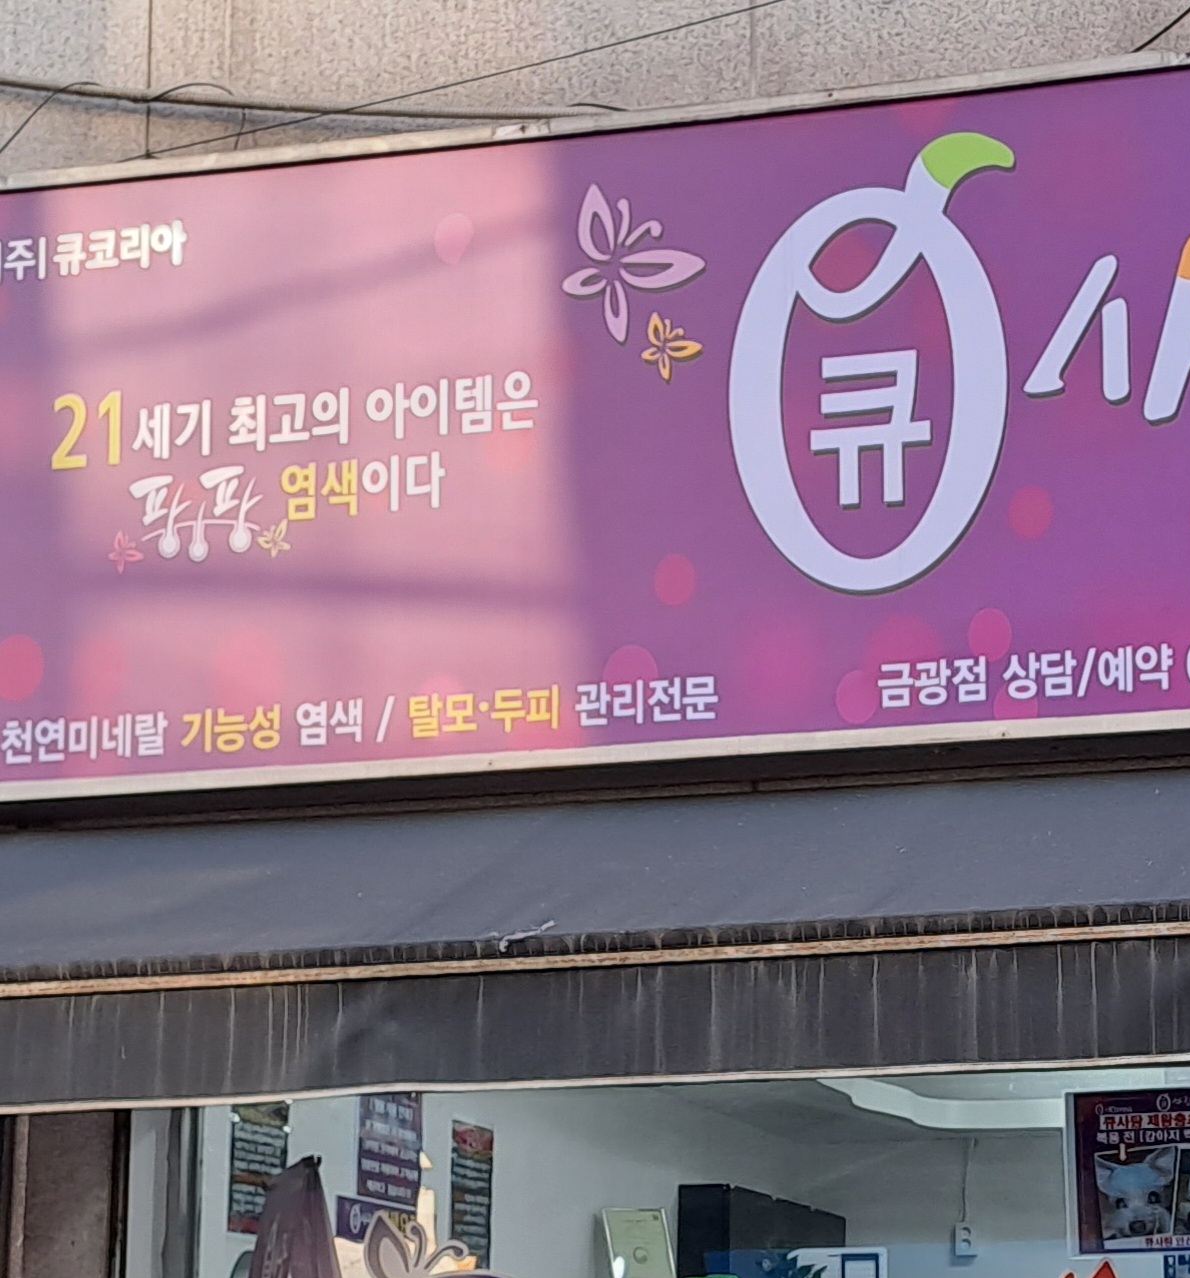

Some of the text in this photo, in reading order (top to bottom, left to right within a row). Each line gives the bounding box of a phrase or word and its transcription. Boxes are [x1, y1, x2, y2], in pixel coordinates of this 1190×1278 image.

[53, 219, 188, 276] 큐코리아
[228, 387, 349, 452] 최고의
[365, 371, 539, 443] 아이템은
[877, 657, 989, 708] 금광점
[1002, 642, 1174, 700] 상담/예약
[2, 711, 168, 766] 천연미네랄
[181, 705, 282, 753] 기능성
[295, 697, 364, 745] 염색
[574, 674, 719, 726] 관리전문
